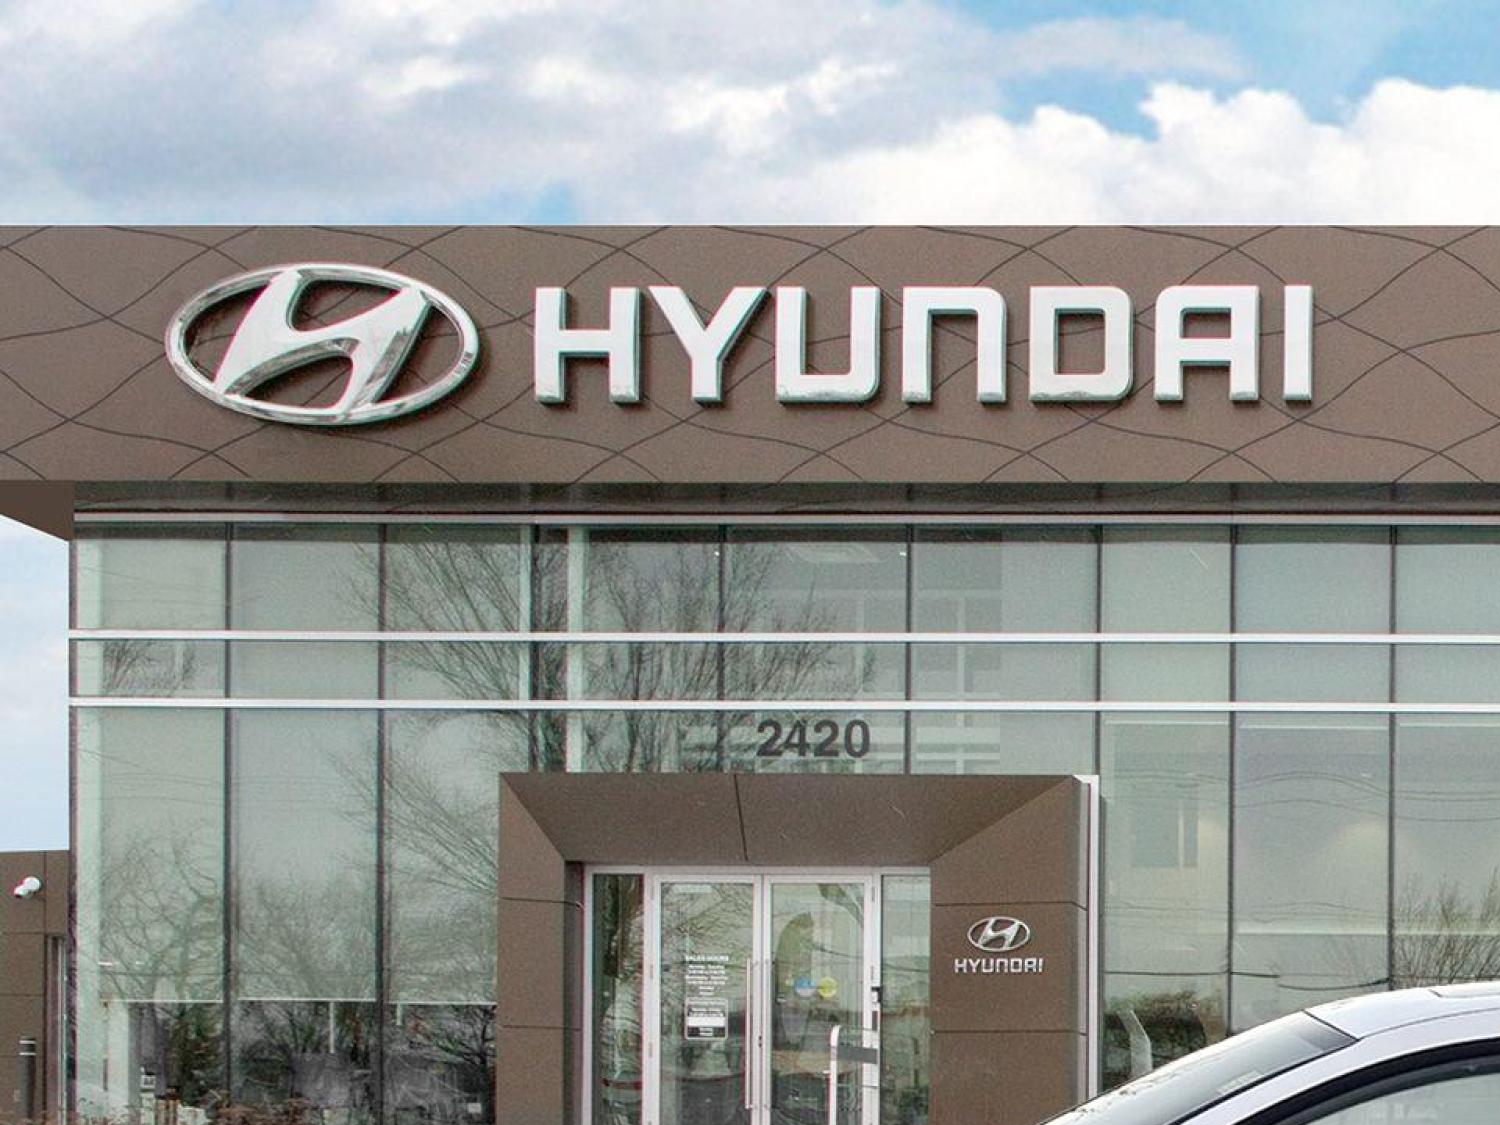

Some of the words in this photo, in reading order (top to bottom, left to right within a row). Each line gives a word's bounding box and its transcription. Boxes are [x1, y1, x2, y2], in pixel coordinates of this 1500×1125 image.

[533, 285, 1316, 404] HYUNDAI
[757, 719, 870, 758] 2420
[954, 957, 1044, 973] HYUNDAI
